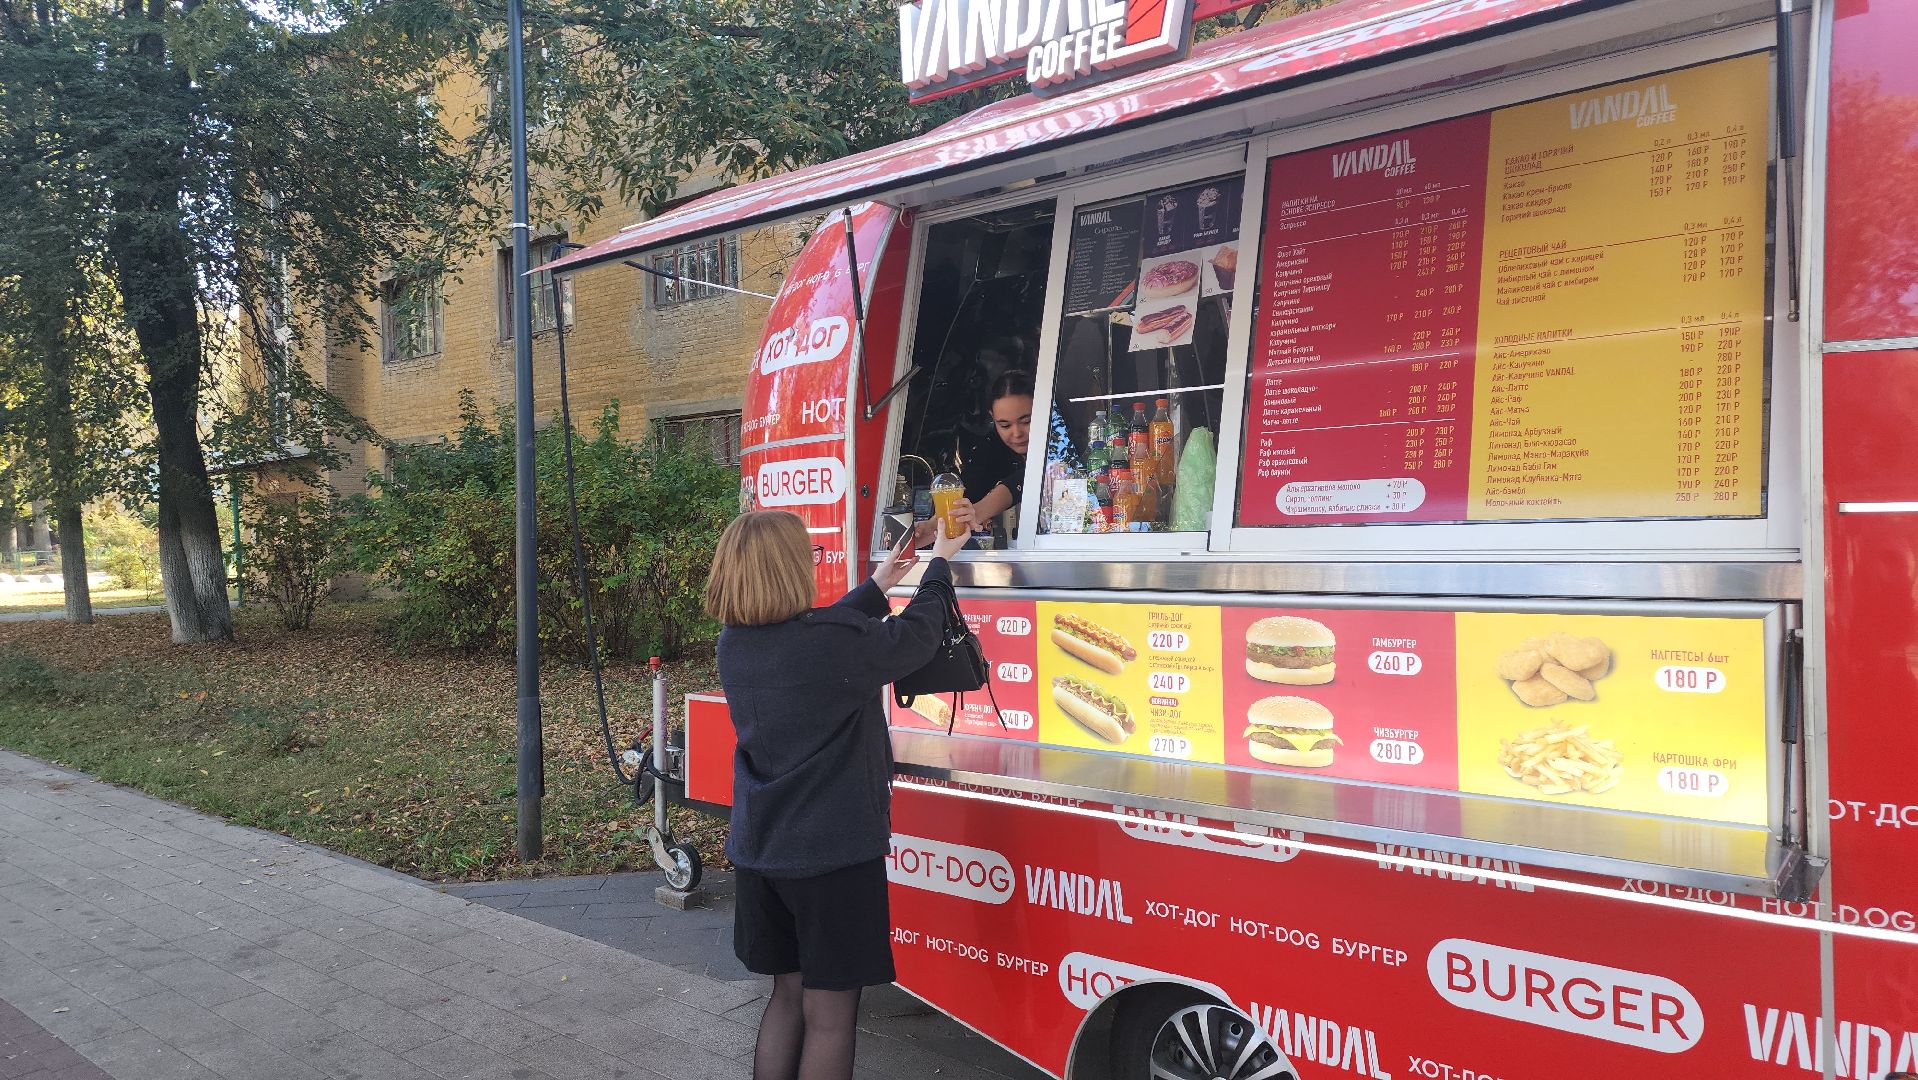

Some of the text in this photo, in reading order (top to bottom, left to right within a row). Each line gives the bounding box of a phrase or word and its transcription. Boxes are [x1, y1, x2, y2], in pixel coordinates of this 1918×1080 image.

[1026, 19, 1124, 83] COFFEE
[1569, 84, 1678, 129] VANDAL
[1636, 110, 1677, 128] COFFEE
[1704, 145, 1710, 153] Р
[1740, 138, 1746, 147] Р
[1332, 139, 1417, 178] VANDAL
[1504, 154, 1530, 166] КАКАО
[1667, 151, 1673, 160] Р
[1703, 156, 1709, 165] Р
[1740, 150, 1746, 159] Р
[1384, 163, 1416, 178] COFFEE
[1504, 161, 1542, 175] ШОКОЛАД
[1667, 163, 1673, 172] Р
[1703, 168, 1709, 177] Р
[1740, 162, 1746, 171] Р
[1503, 180, 1526, 190] Какао
[1666, 175, 1672, 183] Р
[1703, 180, 1708, 189] Р
[1739, 174, 1746, 183] Р
[1503, 182, 1573, 200] Какао крем-брюле
[1666, 186, 1672, 195] Р
[1502, 202, 1524, 211] Какао
[1080, 209, 1113, 227] VANDAL
[1501, 206, 1567, 223] Горячий шоколад
[1499, 239, 1568, 259] РЕЦЕПТОВЫЙ ЧАЙ
[1498, 260, 1548, 273] Облепиховый
[1550, 258, 1564, 267] чай
[1571, 250, 1605, 264] корицей
[1496, 272, 1536, 284] Имбирный
[1538, 270, 1552, 279] чай
[1559, 265, 1595, 276] лимоном
[1496, 282, 1541, 295] Малиновый
[1542, 280, 1556, 289] чай
[1496, 293, 1546, 306] Чай листовой
[1494, 328, 1574, 345] ХОЛОДНЫЕ НАПИТКИ
[765, 324, 842, 364] ХОТДОГ
[1493, 347, 1551, 360] Айс-Американо
[1492, 360, 1545, 371] Айс-Капучино
[1545, 366, 1575, 377] VANDAL
[1491, 383, 1529, 393] Айс-Латте
[801, 397, 846, 425] HOT
[1489, 417, 1521, 427] Айс-Чай
[1488, 425, 1563, 439] Лимонад Арбузный
[1260, 438, 1273, 448] Раф
[1488, 441, 1522, 450] Лимонад
[1259, 448, 1272, 458] Раф
[1487, 448, 1590, 462] Лимонад Манго-Маракуйя
[1486, 464, 1520, 473] Лимонад
[762, 467, 835, 498] BURGER
[1486, 472, 1582, 485] Лимонад Клубника-Мята
[1485, 497, 1562, 508] Молочный коктейль
[1148, 611, 1184, 622] ГРИЛЬ-ДОГ
[1000, 619, 1028, 634] 220 Р
[1152, 633, 1184, 649] 220 Р
[1372, 637, 1417, 649] ГАМБУРГЕР
[1375, 654, 1416, 672] 260 Р
[1651, 649, 1730, 664] НАГГЕТСЫ 6шт
[1001, 665, 1029, 681] 240 Р
[1664, 669, 1718, 690] 180 Р
[1153, 674, 1185, 691] 240 Р
[1023, 714, 1030, 728] Р
[1373, 726, 1419, 740] ЧИЗБУРГЕР
[1154, 737, 1187, 754] 270 Р
[1376, 742, 1417, 762] 280 Р
[1652, 751, 1737, 770] КАРТОШКА ФРИ
[1666, 770, 1720, 793] 180 Р
[886, 845, 1010, 893] HOT-DOG
[1024, 864, 1133, 925] VANDAL
[1145, 899, 1409, 967] ХОТ-ДОГ HOT-DOG БУРГЕР
[926, 934, 989, 963] HOT-DOG
[997, 952, 1049, 977] БУРГЕР
[1446, 951, 1690, 1041] BURGER
[1249, 1001, 1392, 1080] VANDAL
[1407, 1055, 1506, 1080] ХОТ-
